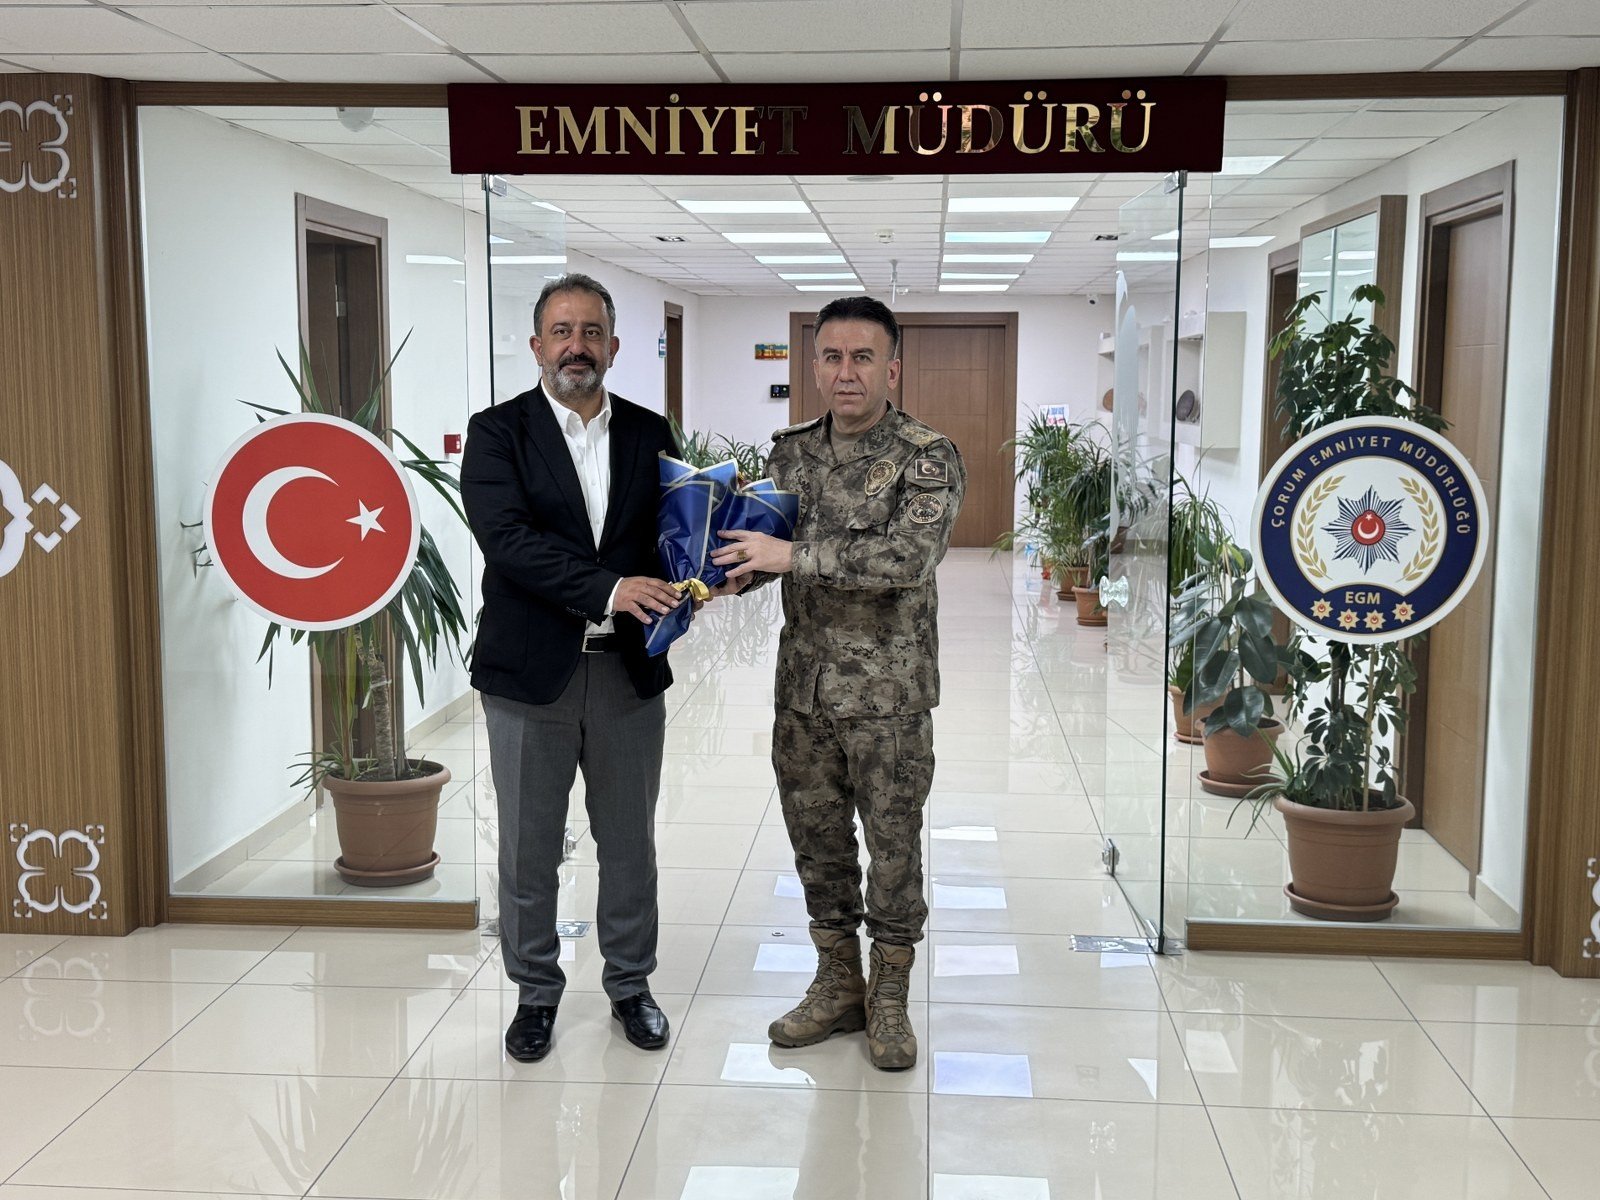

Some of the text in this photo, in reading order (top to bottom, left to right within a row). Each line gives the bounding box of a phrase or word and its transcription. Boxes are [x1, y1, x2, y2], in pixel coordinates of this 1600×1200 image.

[515, 89, 1157, 155] EMNİYET MÜDÜRÜ
[1271, 436, 1471, 534] ÇORUM EMNİYET MÜDÜRLÜĞÜ
[1345, 591, 1381, 605] EGM
